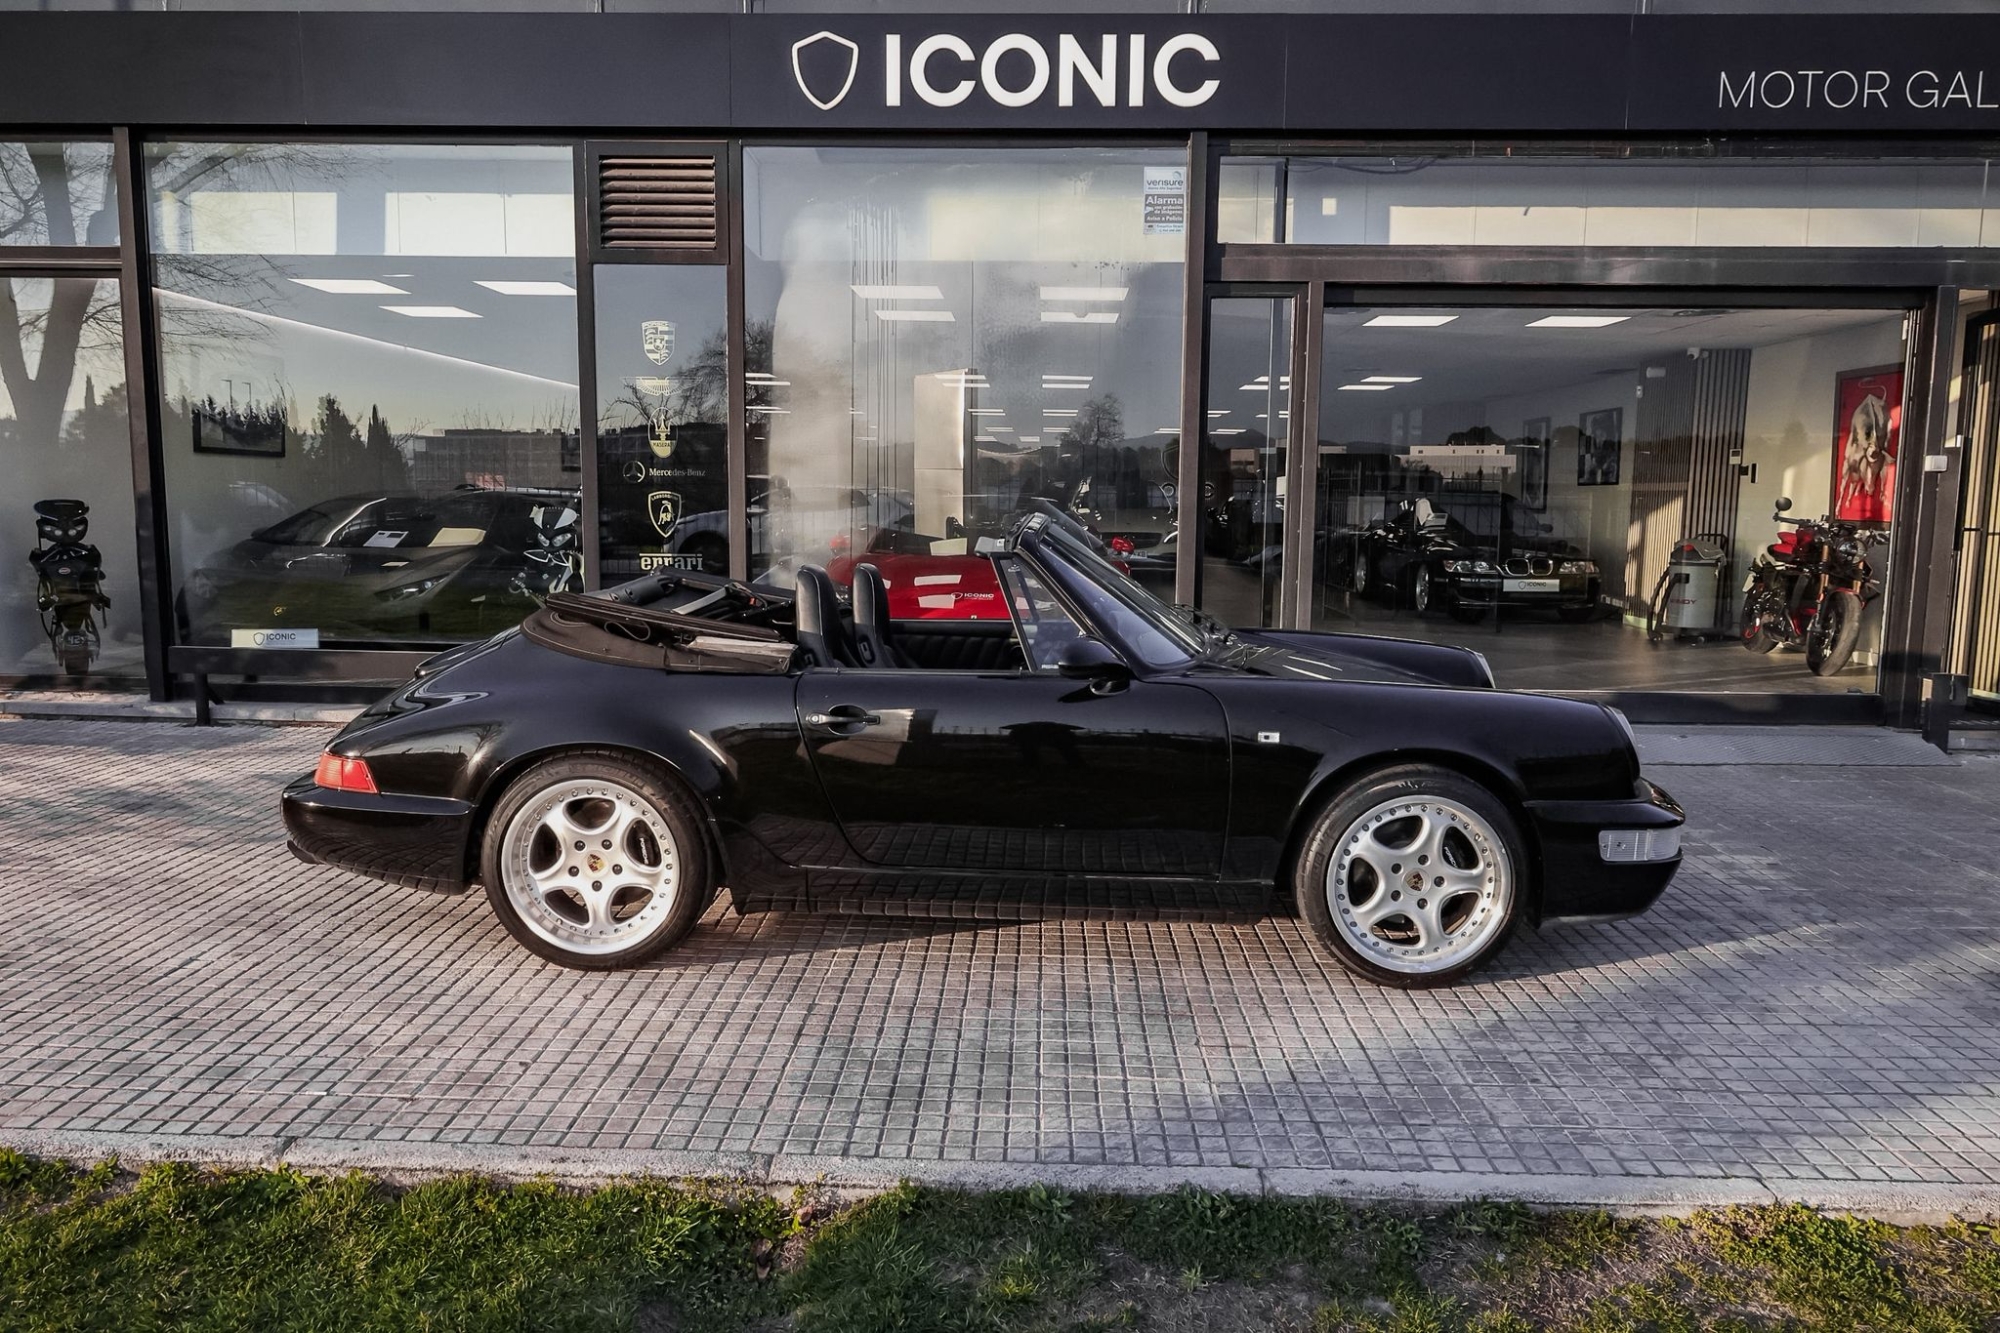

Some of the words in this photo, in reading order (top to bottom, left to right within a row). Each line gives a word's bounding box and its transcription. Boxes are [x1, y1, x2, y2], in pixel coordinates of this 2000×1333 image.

[886, 33, 1220, 107] ICONIC
[1718, 70, 1891, 108] MOTOR
[1905, 70, 2000, 108] GAL
[1146, 179, 1184, 187] verisure
[1146, 195, 1183, 204] Alarma
[649, 467, 706, 477] Mercedes-Benz
[266, 633, 296, 641] ICONIC
